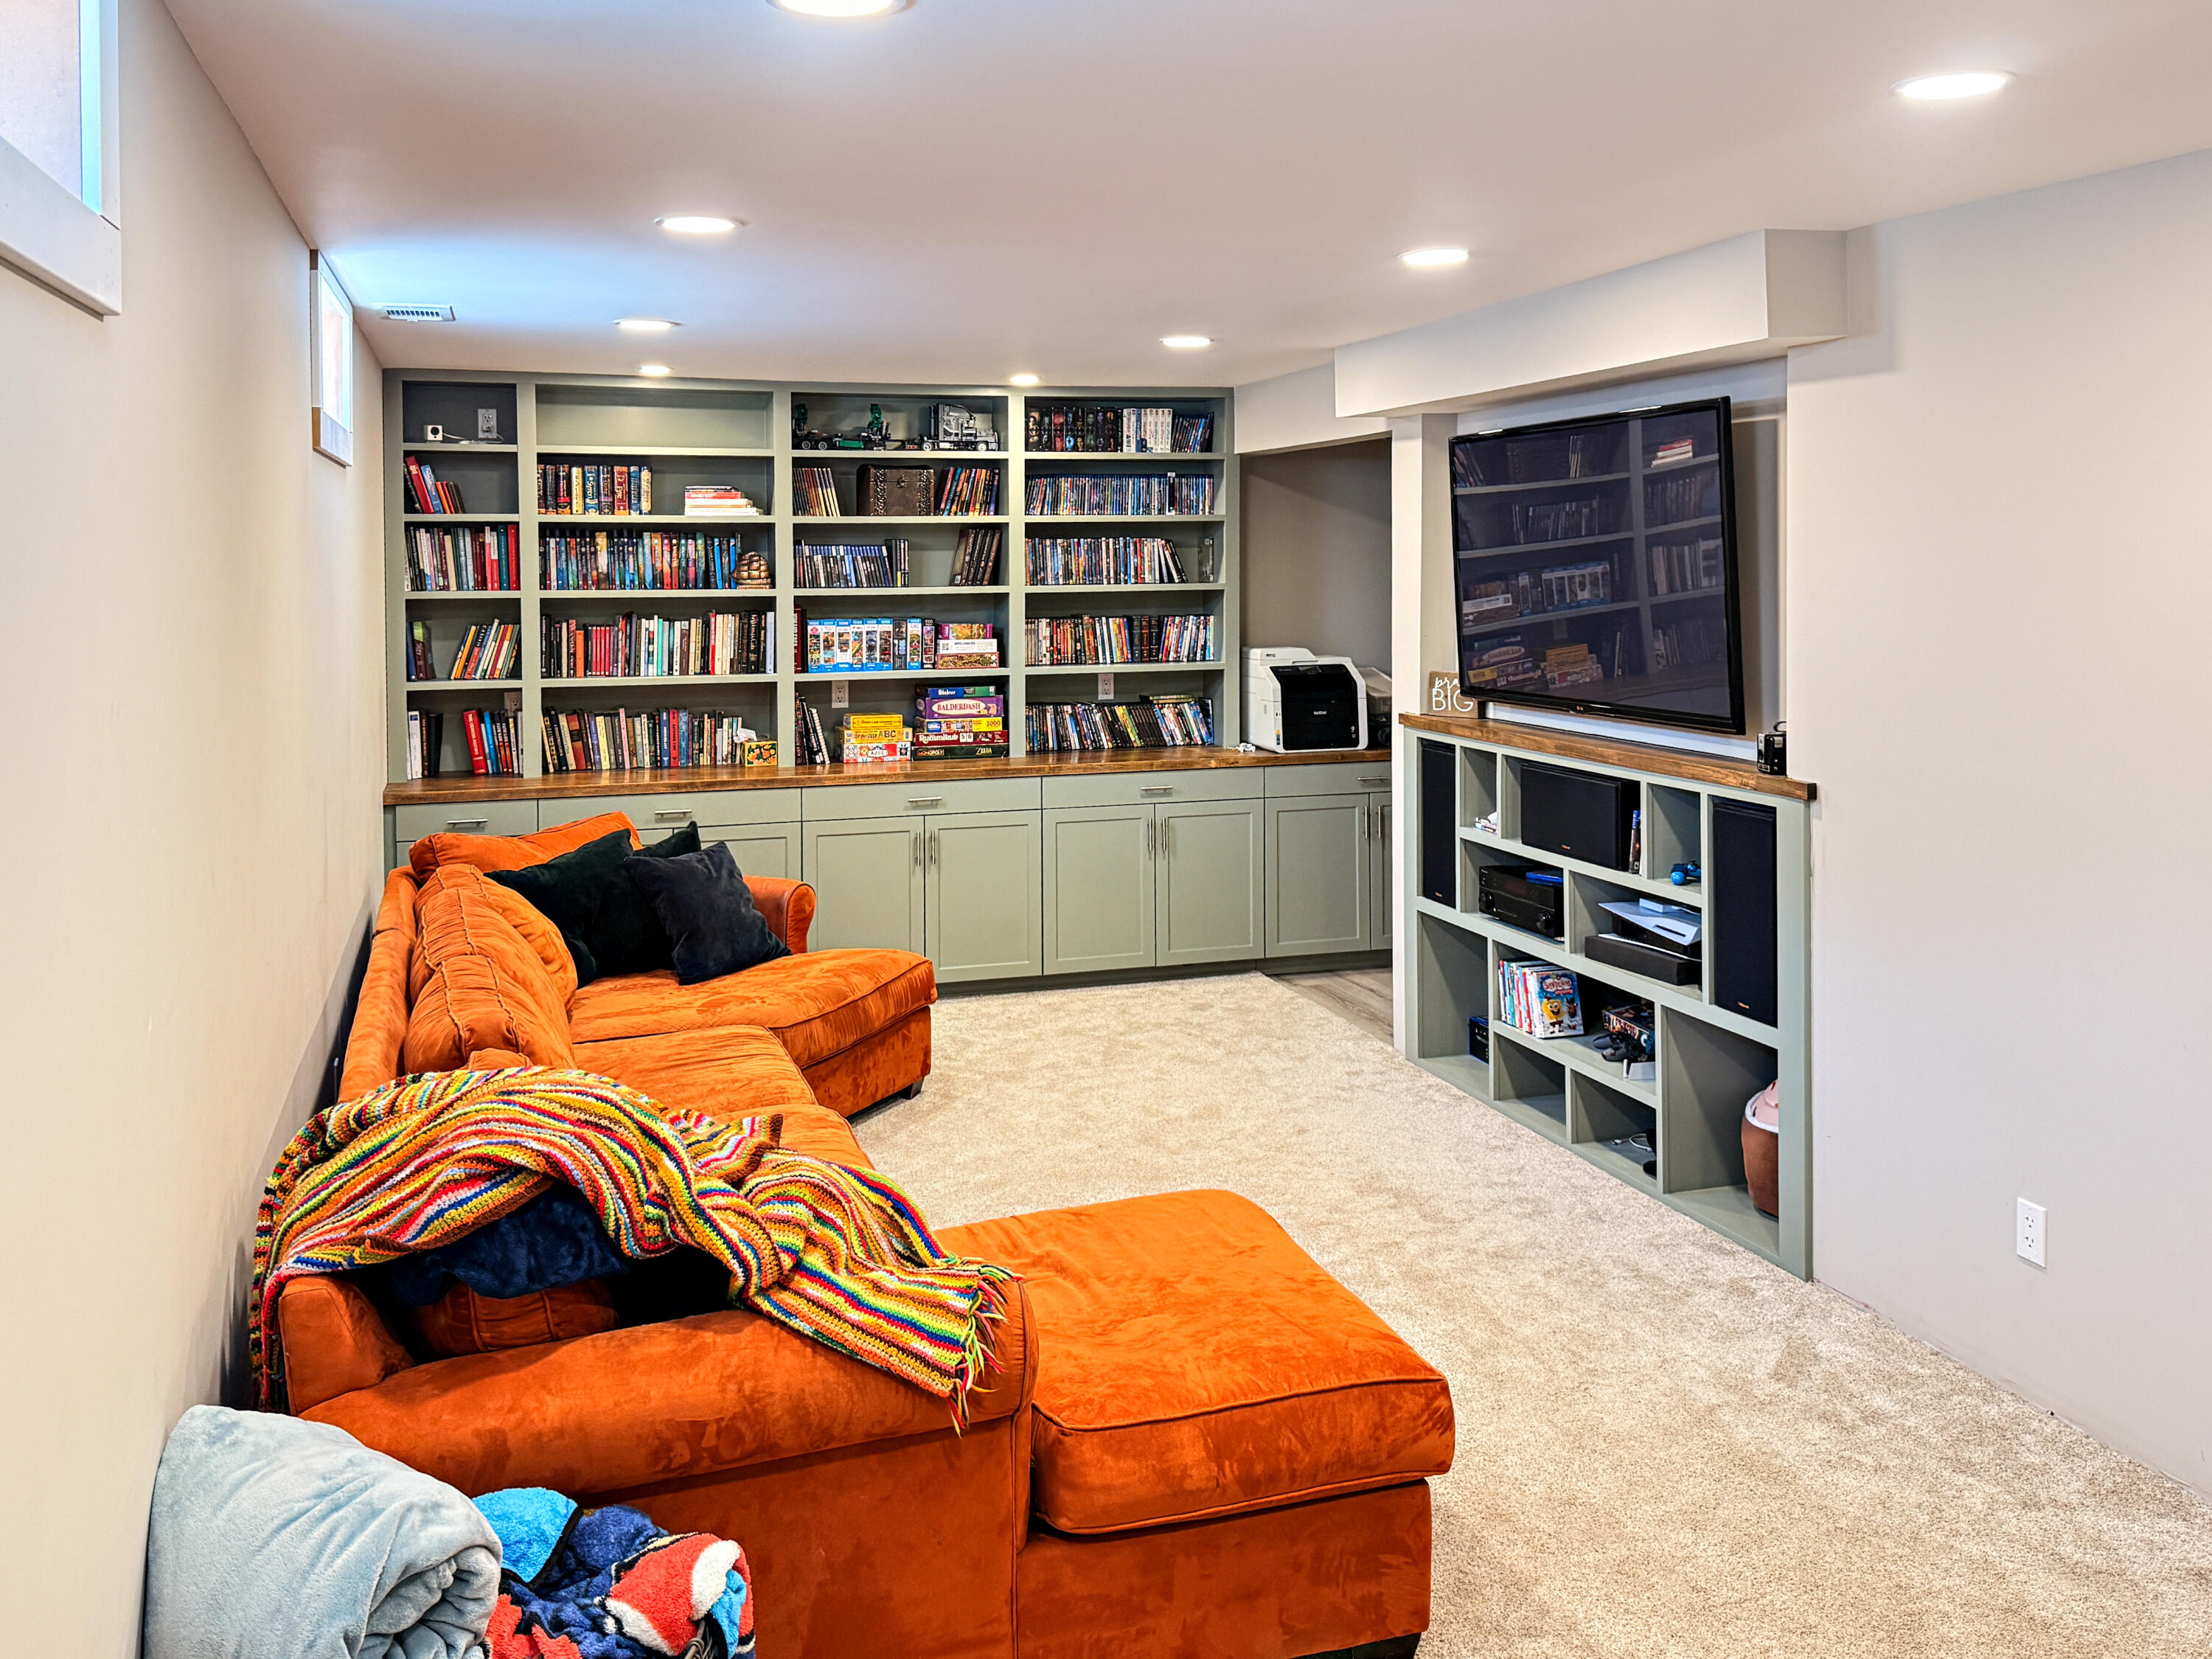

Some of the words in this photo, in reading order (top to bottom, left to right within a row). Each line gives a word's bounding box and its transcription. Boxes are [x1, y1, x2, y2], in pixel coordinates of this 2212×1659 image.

[1434, 676, 1461, 695] pra
[1432, 688, 1474, 712] BIG
[937, 703, 981, 711] BALDERDASH
[987, 720, 1001, 728] 1000
[879, 730, 897, 738] ABC
[919, 734, 959, 744] Rummikub
